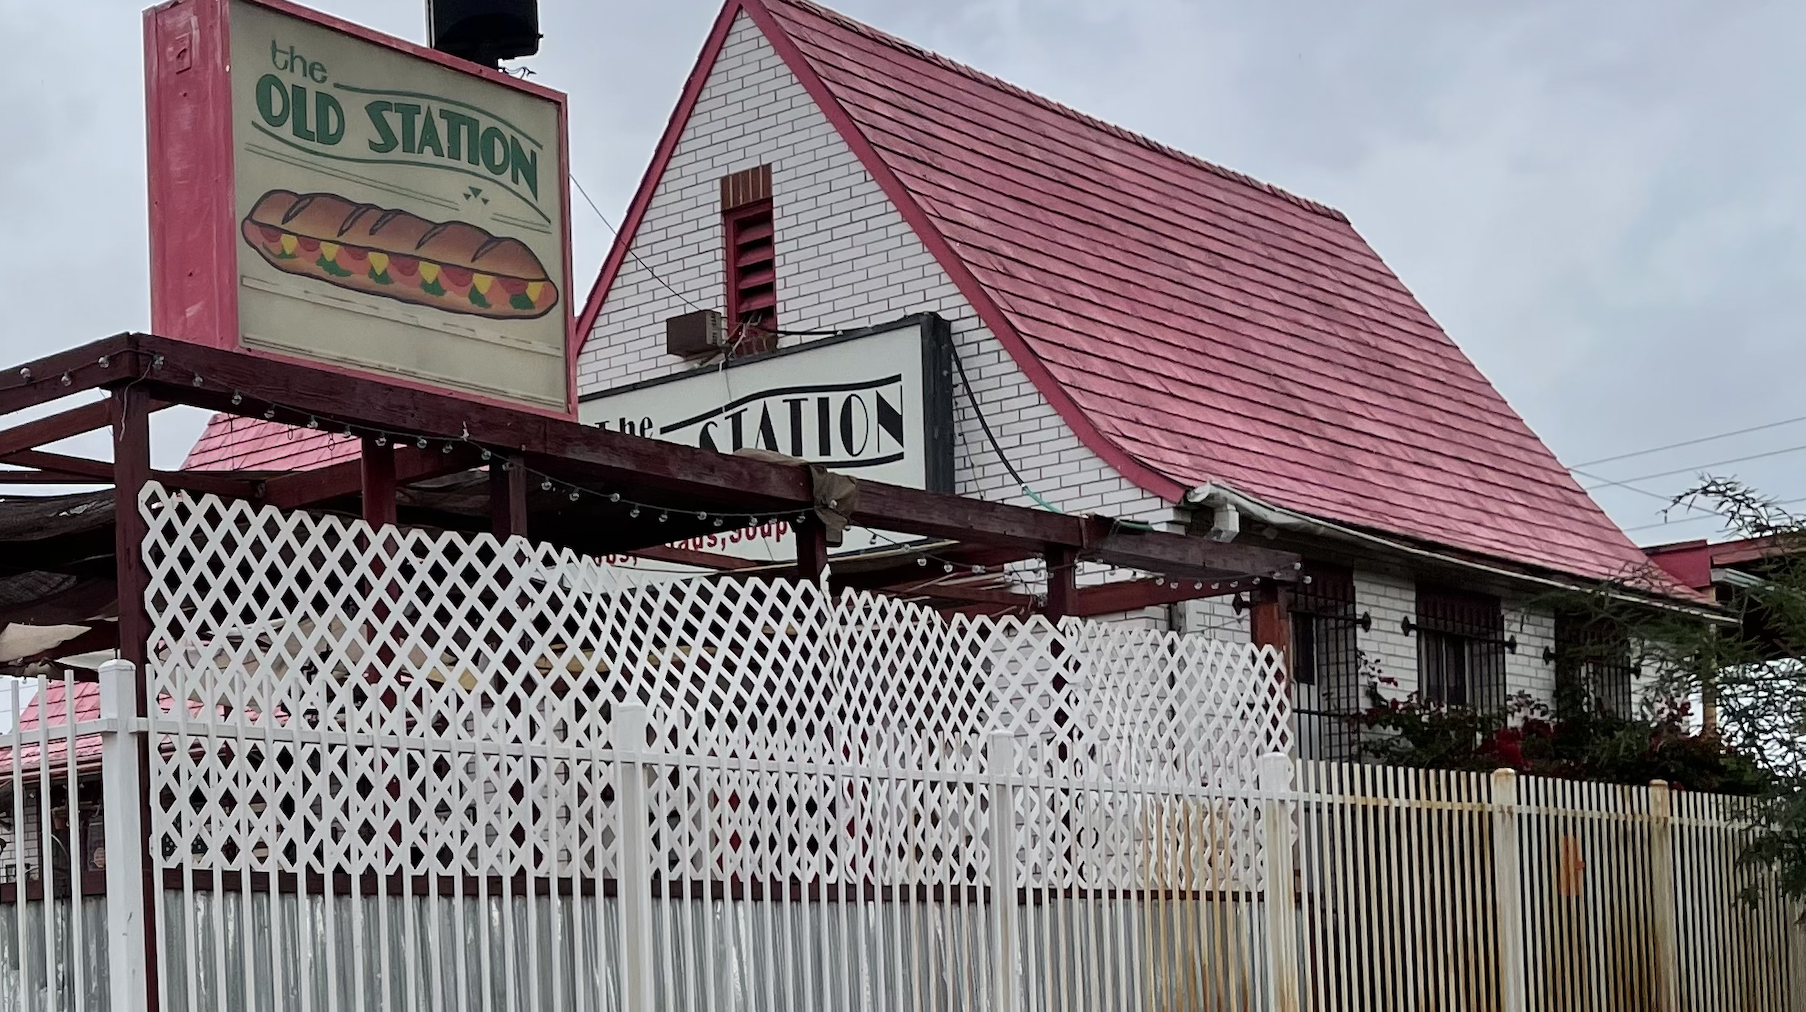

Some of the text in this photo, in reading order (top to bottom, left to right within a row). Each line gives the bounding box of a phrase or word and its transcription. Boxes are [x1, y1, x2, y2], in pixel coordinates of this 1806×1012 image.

[270, 38, 328, 84] the
[256, 73, 538, 202] OLD STATION
[699, 385, 905, 457] STATION
